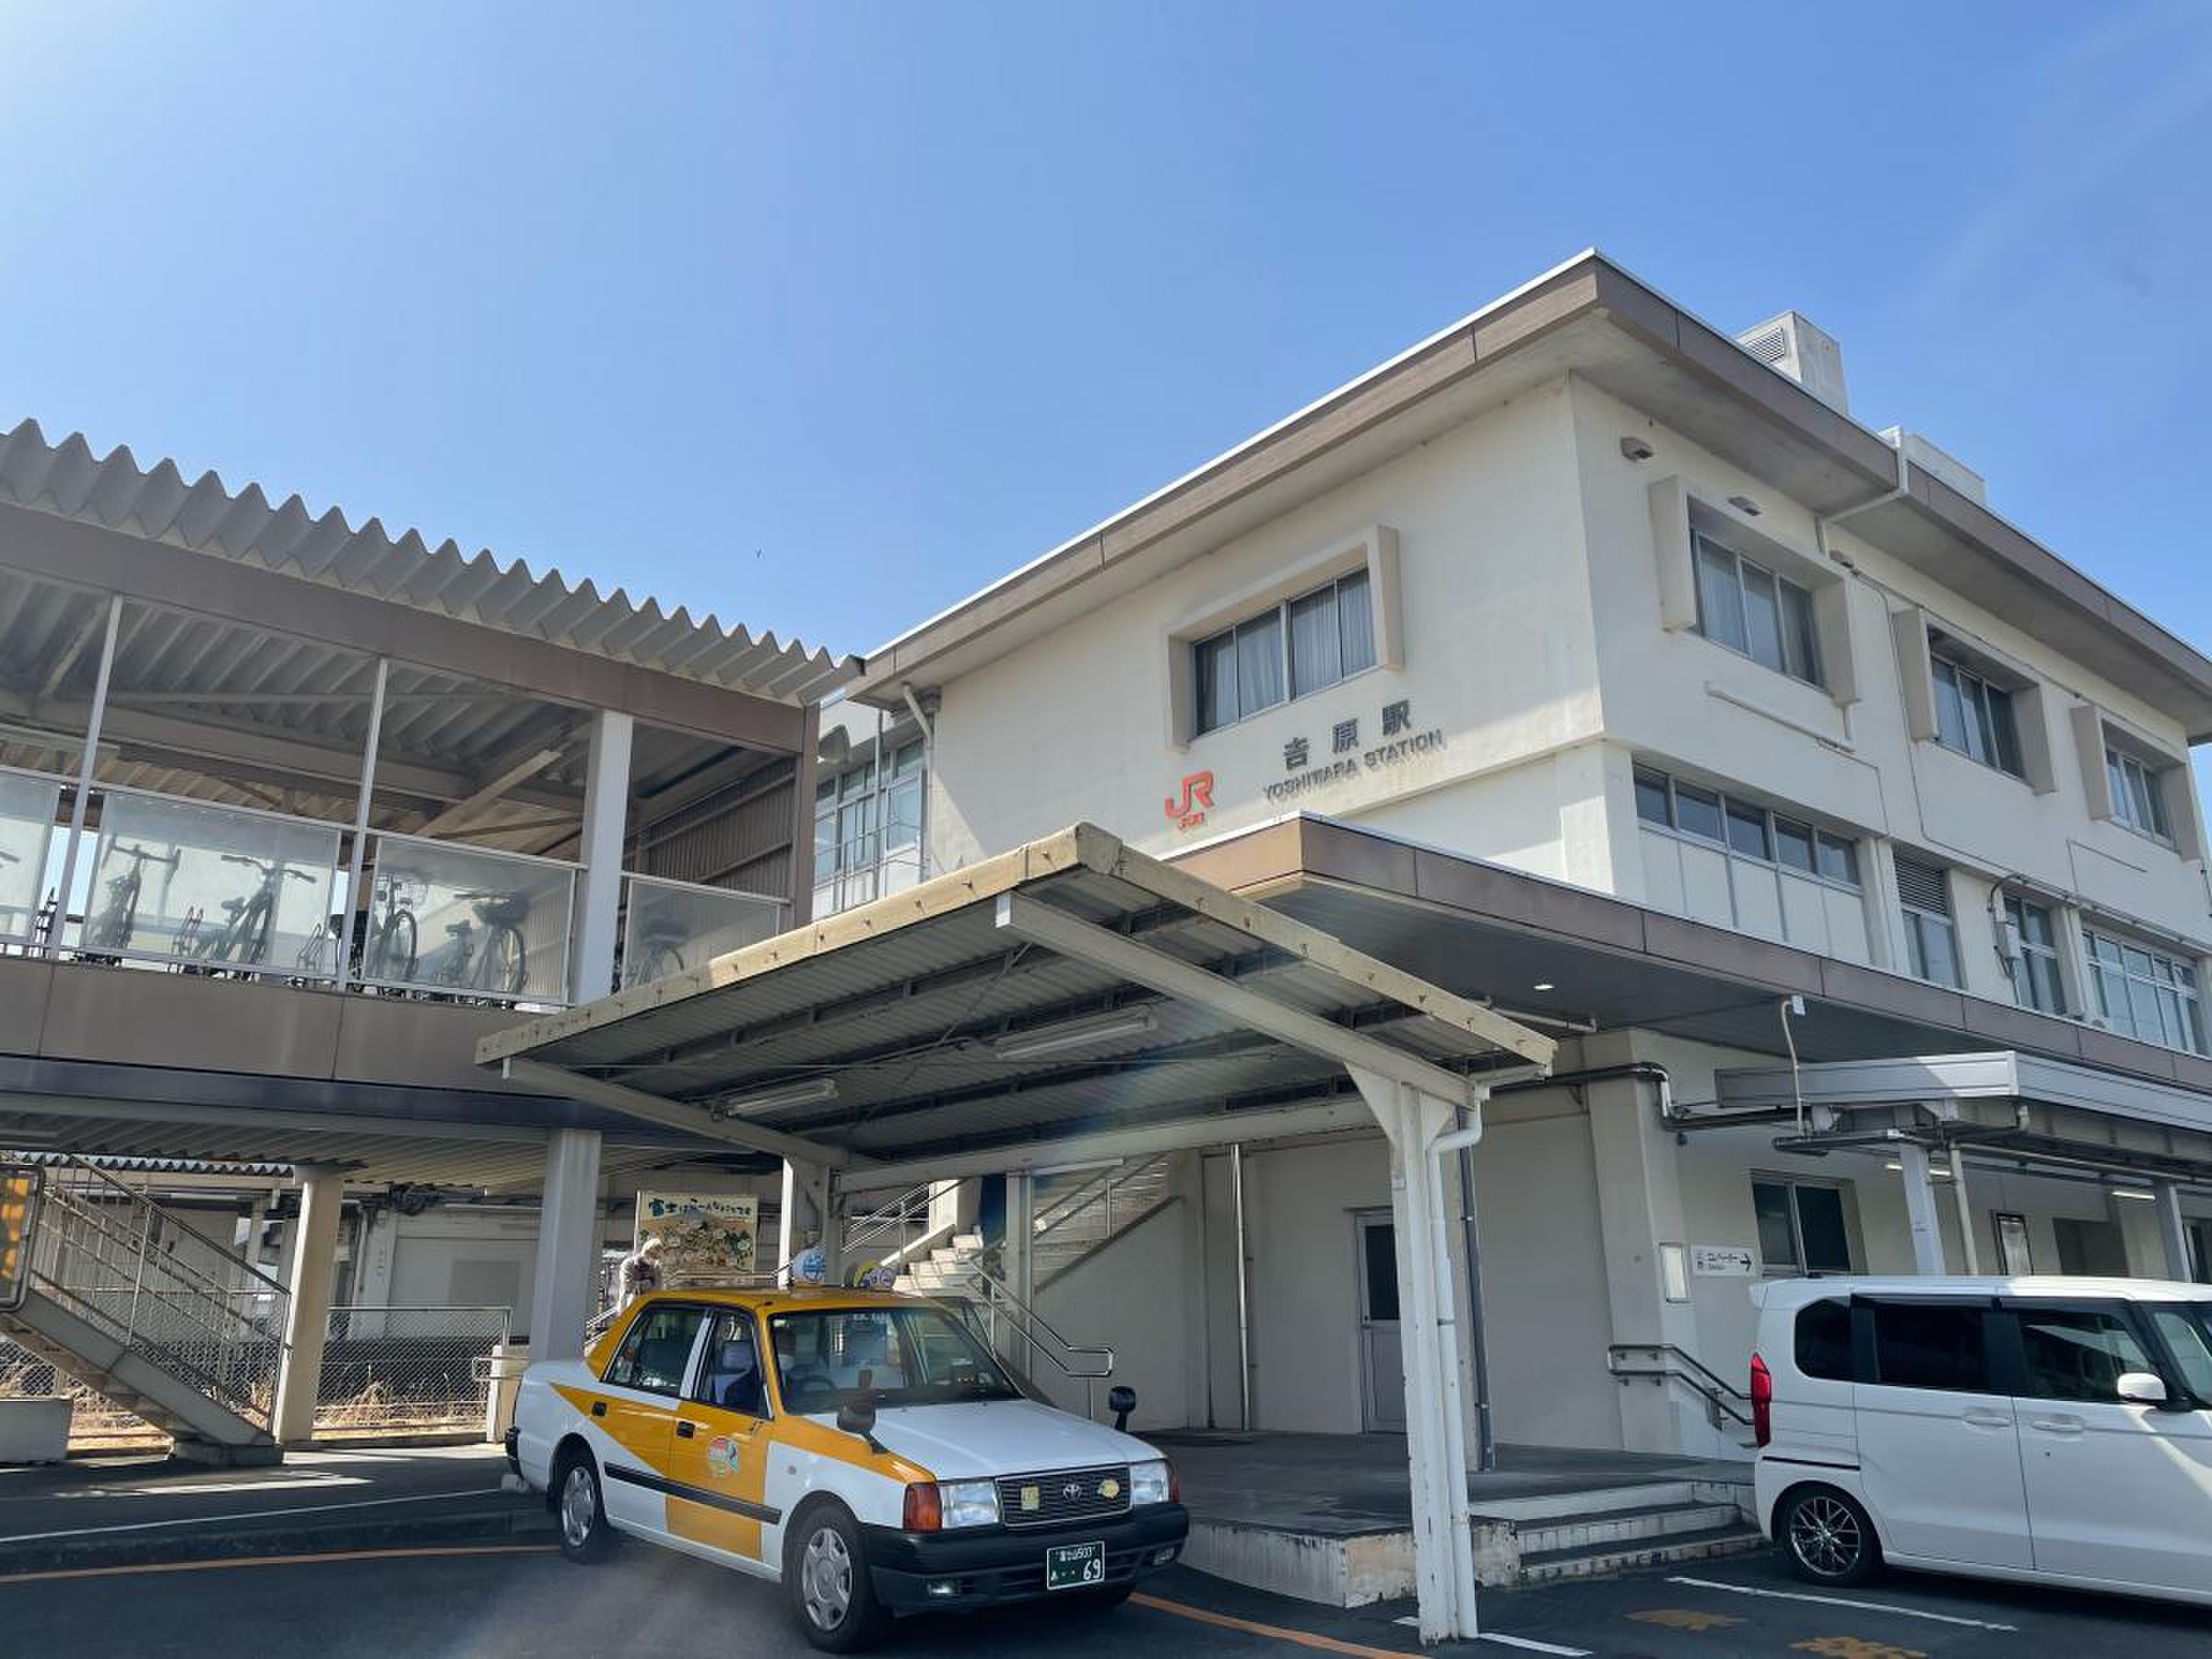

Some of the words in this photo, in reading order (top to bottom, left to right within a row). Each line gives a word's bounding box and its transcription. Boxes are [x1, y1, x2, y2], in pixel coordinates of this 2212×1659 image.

[1263, 759, 1358, 801] YOSHIWARA
[1364, 729, 1443, 768] STATION
[1283, 700, 1413, 771] 吉原駅
[1165, 770, 1214, 818] JR
